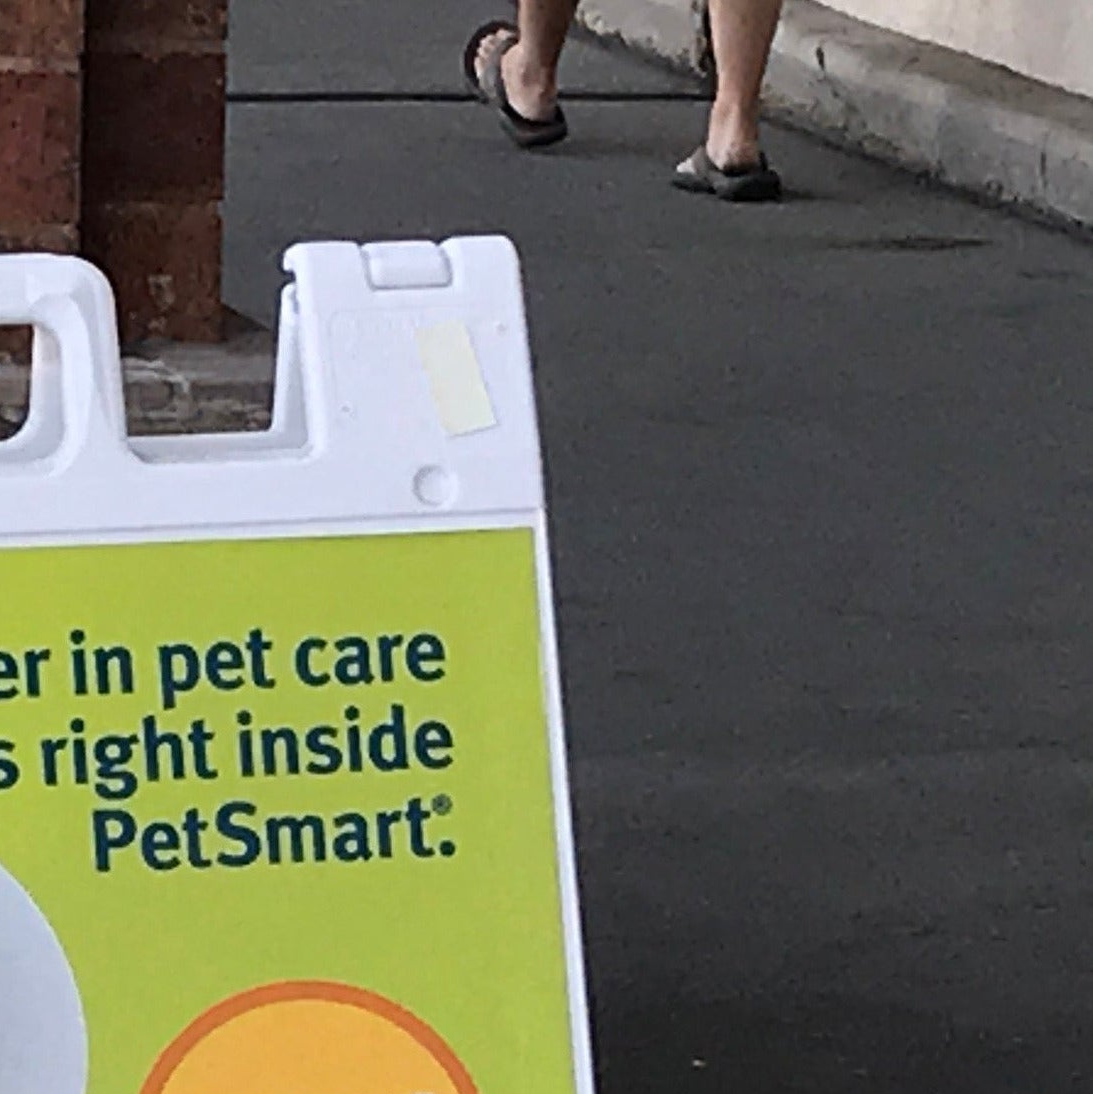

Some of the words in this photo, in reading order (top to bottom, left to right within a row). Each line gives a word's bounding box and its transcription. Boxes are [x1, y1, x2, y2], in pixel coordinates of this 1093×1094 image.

[69, 628, 135, 697] in
[157, 627, 276, 708] pet
[294, 633, 446, 688] care
[41, 714, 218, 801] right
[236, 702, 455, 778] inside
